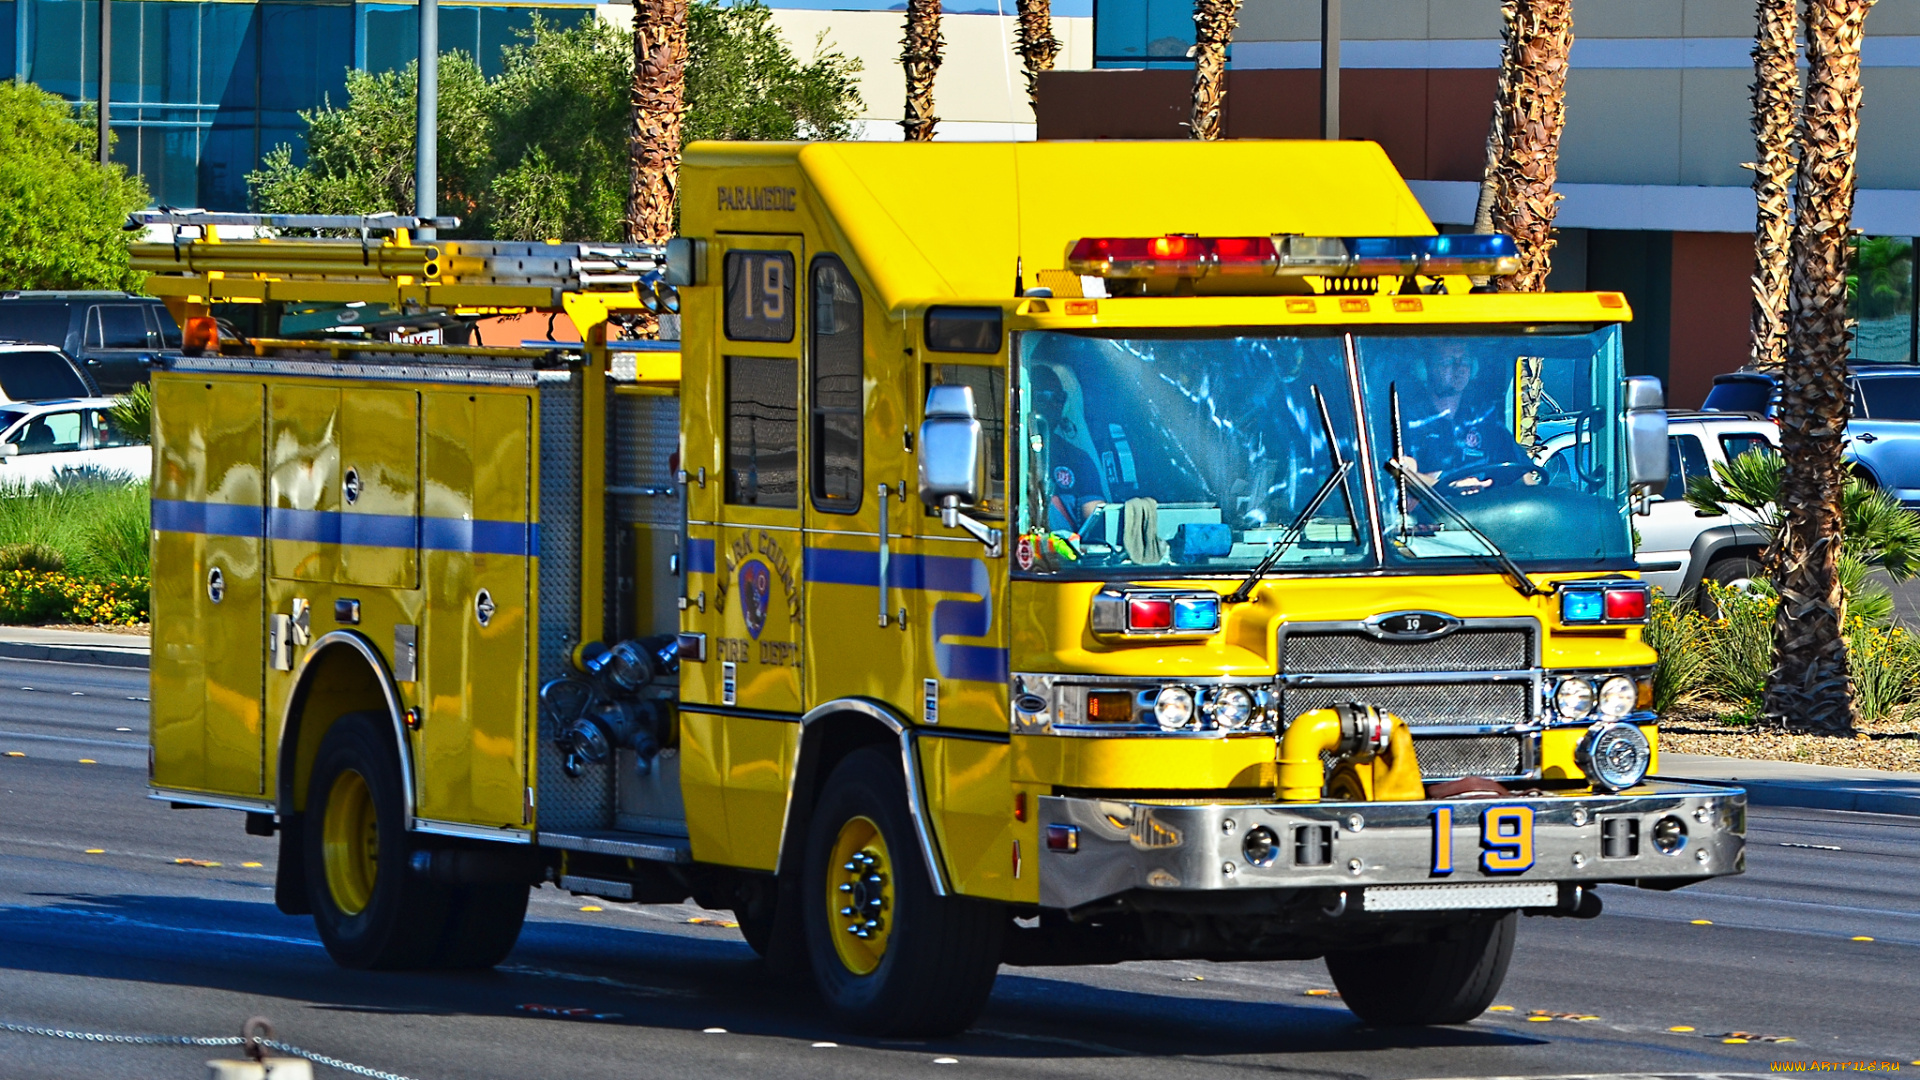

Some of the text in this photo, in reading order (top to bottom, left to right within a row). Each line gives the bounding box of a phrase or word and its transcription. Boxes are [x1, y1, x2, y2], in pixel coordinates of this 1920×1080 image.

[718, 186, 797, 212] PARAMEDIC
[744, 257, 785, 322] 19
[1406, 619, 1421, 631] 19
[716, 637, 749, 663] FIRE
[1430, 804, 1536, 877] 19
